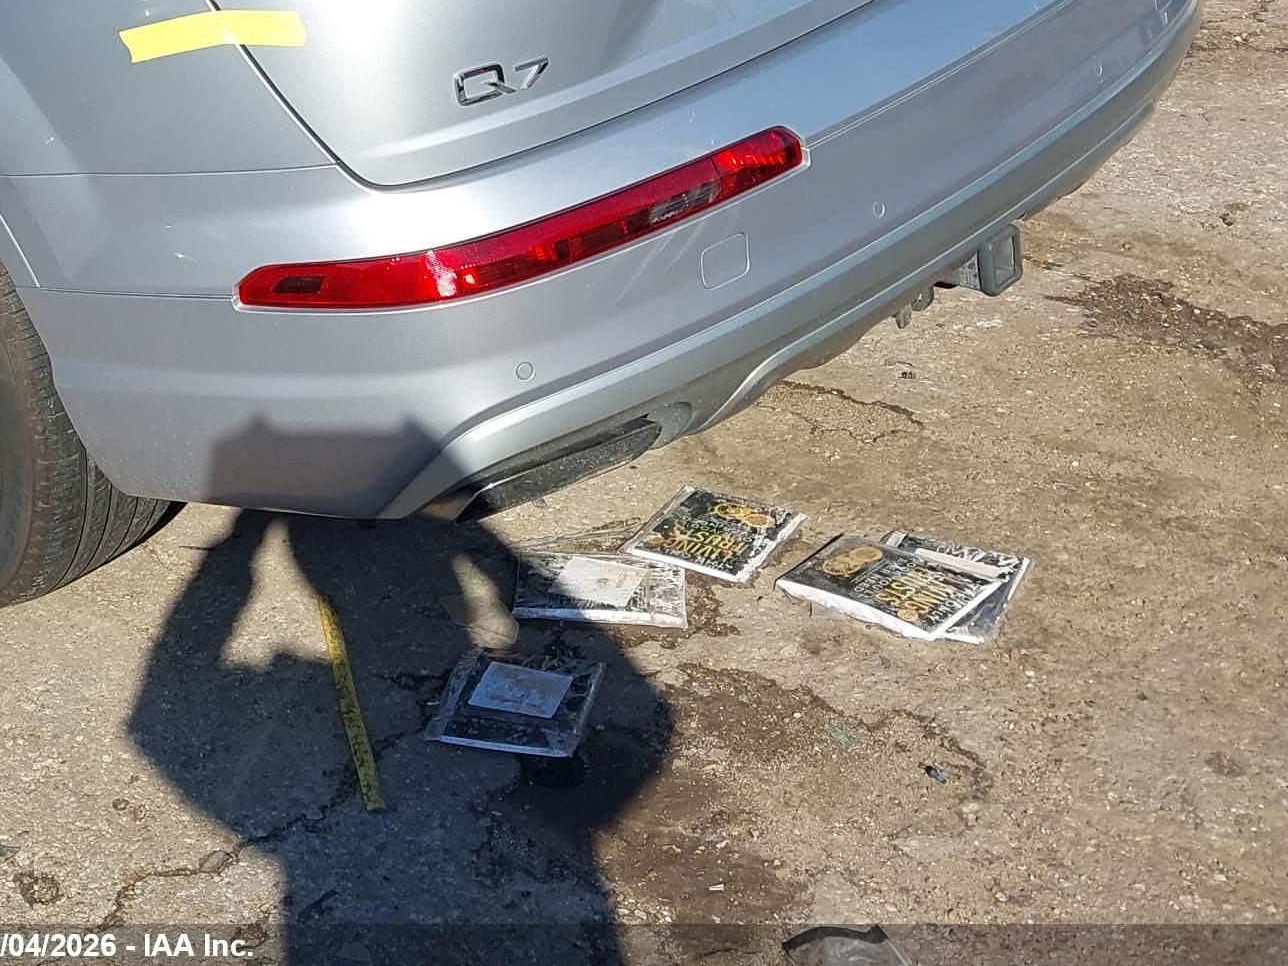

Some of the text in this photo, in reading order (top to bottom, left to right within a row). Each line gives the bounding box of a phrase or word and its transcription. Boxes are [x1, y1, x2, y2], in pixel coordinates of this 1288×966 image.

[453, 56, 549, 106] Q7
[661, 536, 734, 562] LIVING
[666, 523, 751, 553] TRUSTS
